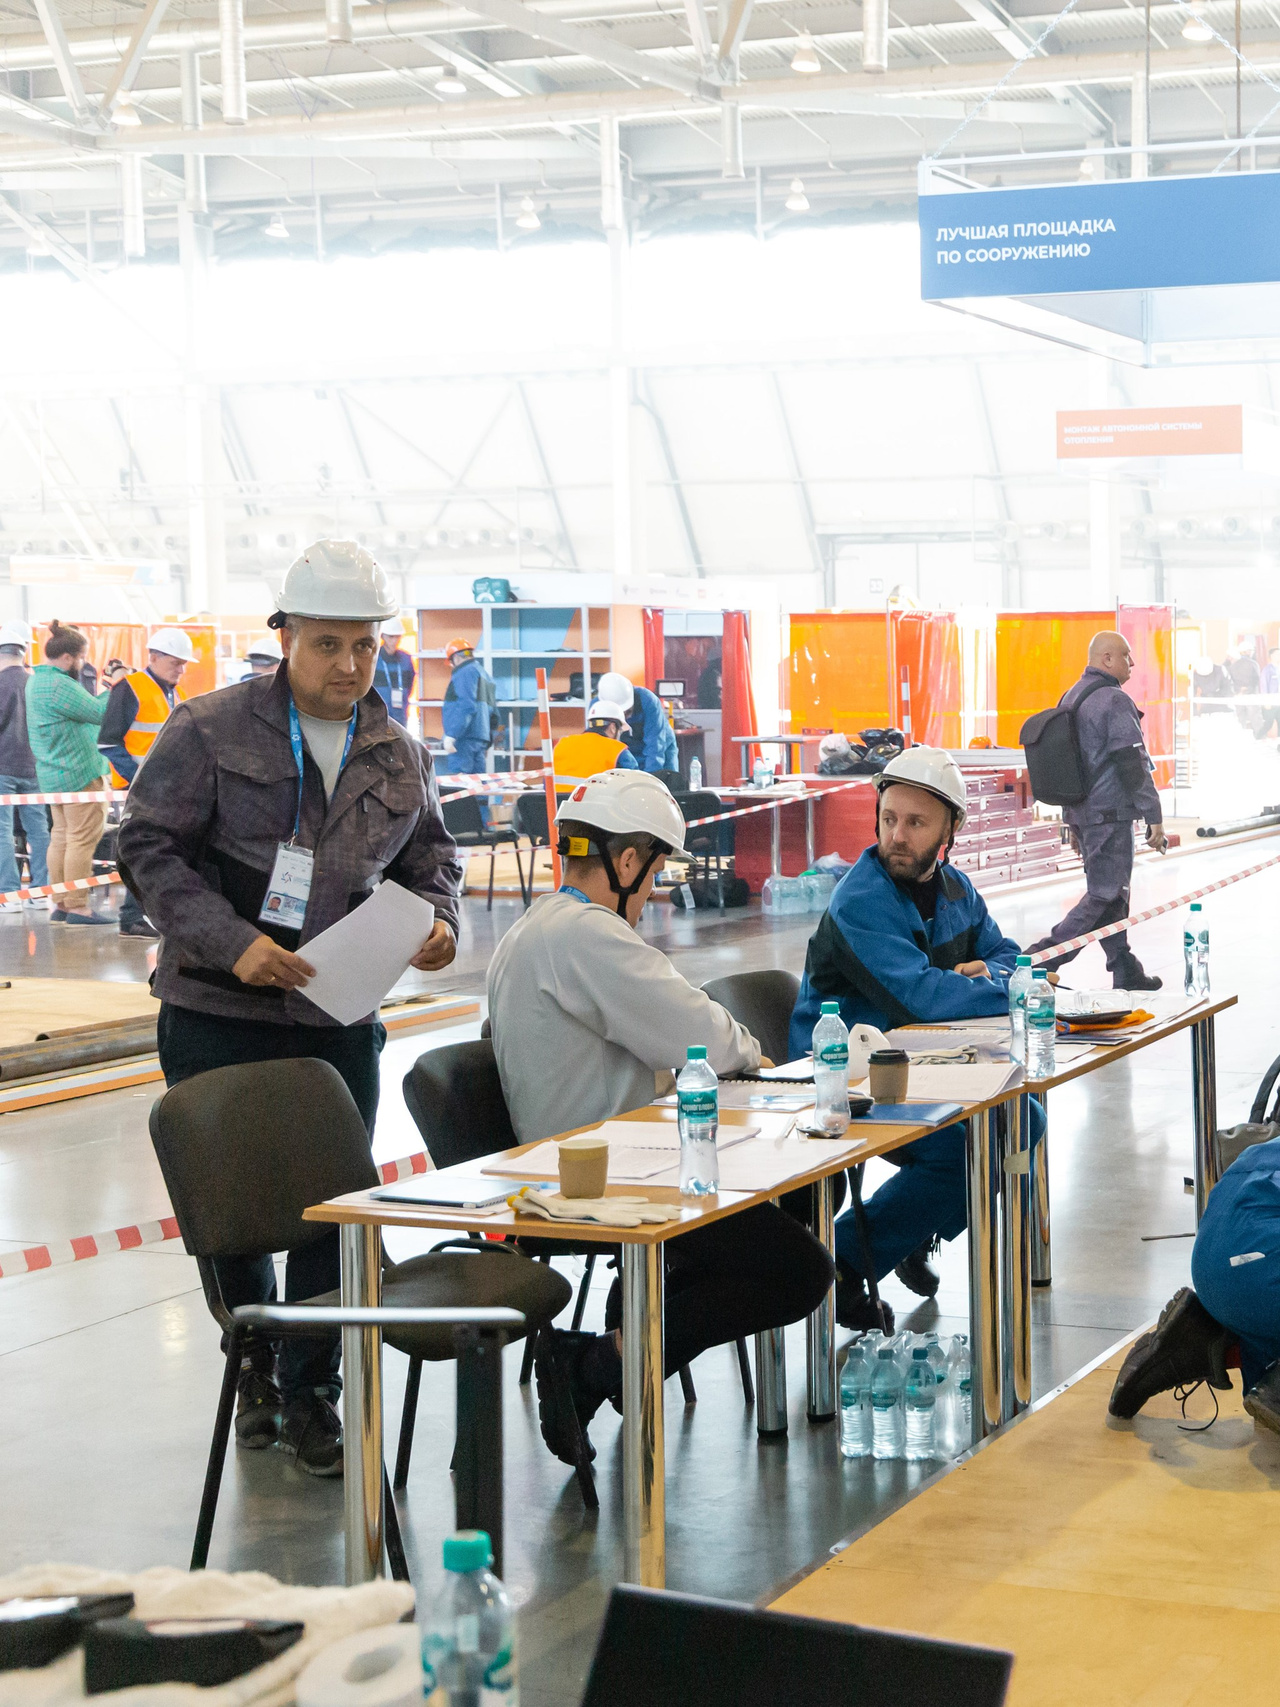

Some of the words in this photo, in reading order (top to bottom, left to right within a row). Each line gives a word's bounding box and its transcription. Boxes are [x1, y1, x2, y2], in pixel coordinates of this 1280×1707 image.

[936, 225, 1008, 241] ЛУЧШАЯ
[1014, 219, 1116, 238] ПЛОЩАДКА
[936, 249, 962, 264] ПО
[965, 243, 1091, 263] СООРУЖЕНИЮ
[1064, 425, 1101, 434] МОНТАЖ
[1102, 422, 1160, 433] АВТОНОМНОЙ
[1161, 421, 1203, 431] СИСТЕМЫ
[1064, 435, 1114, 444] ОТОПЛЕНИЯ
